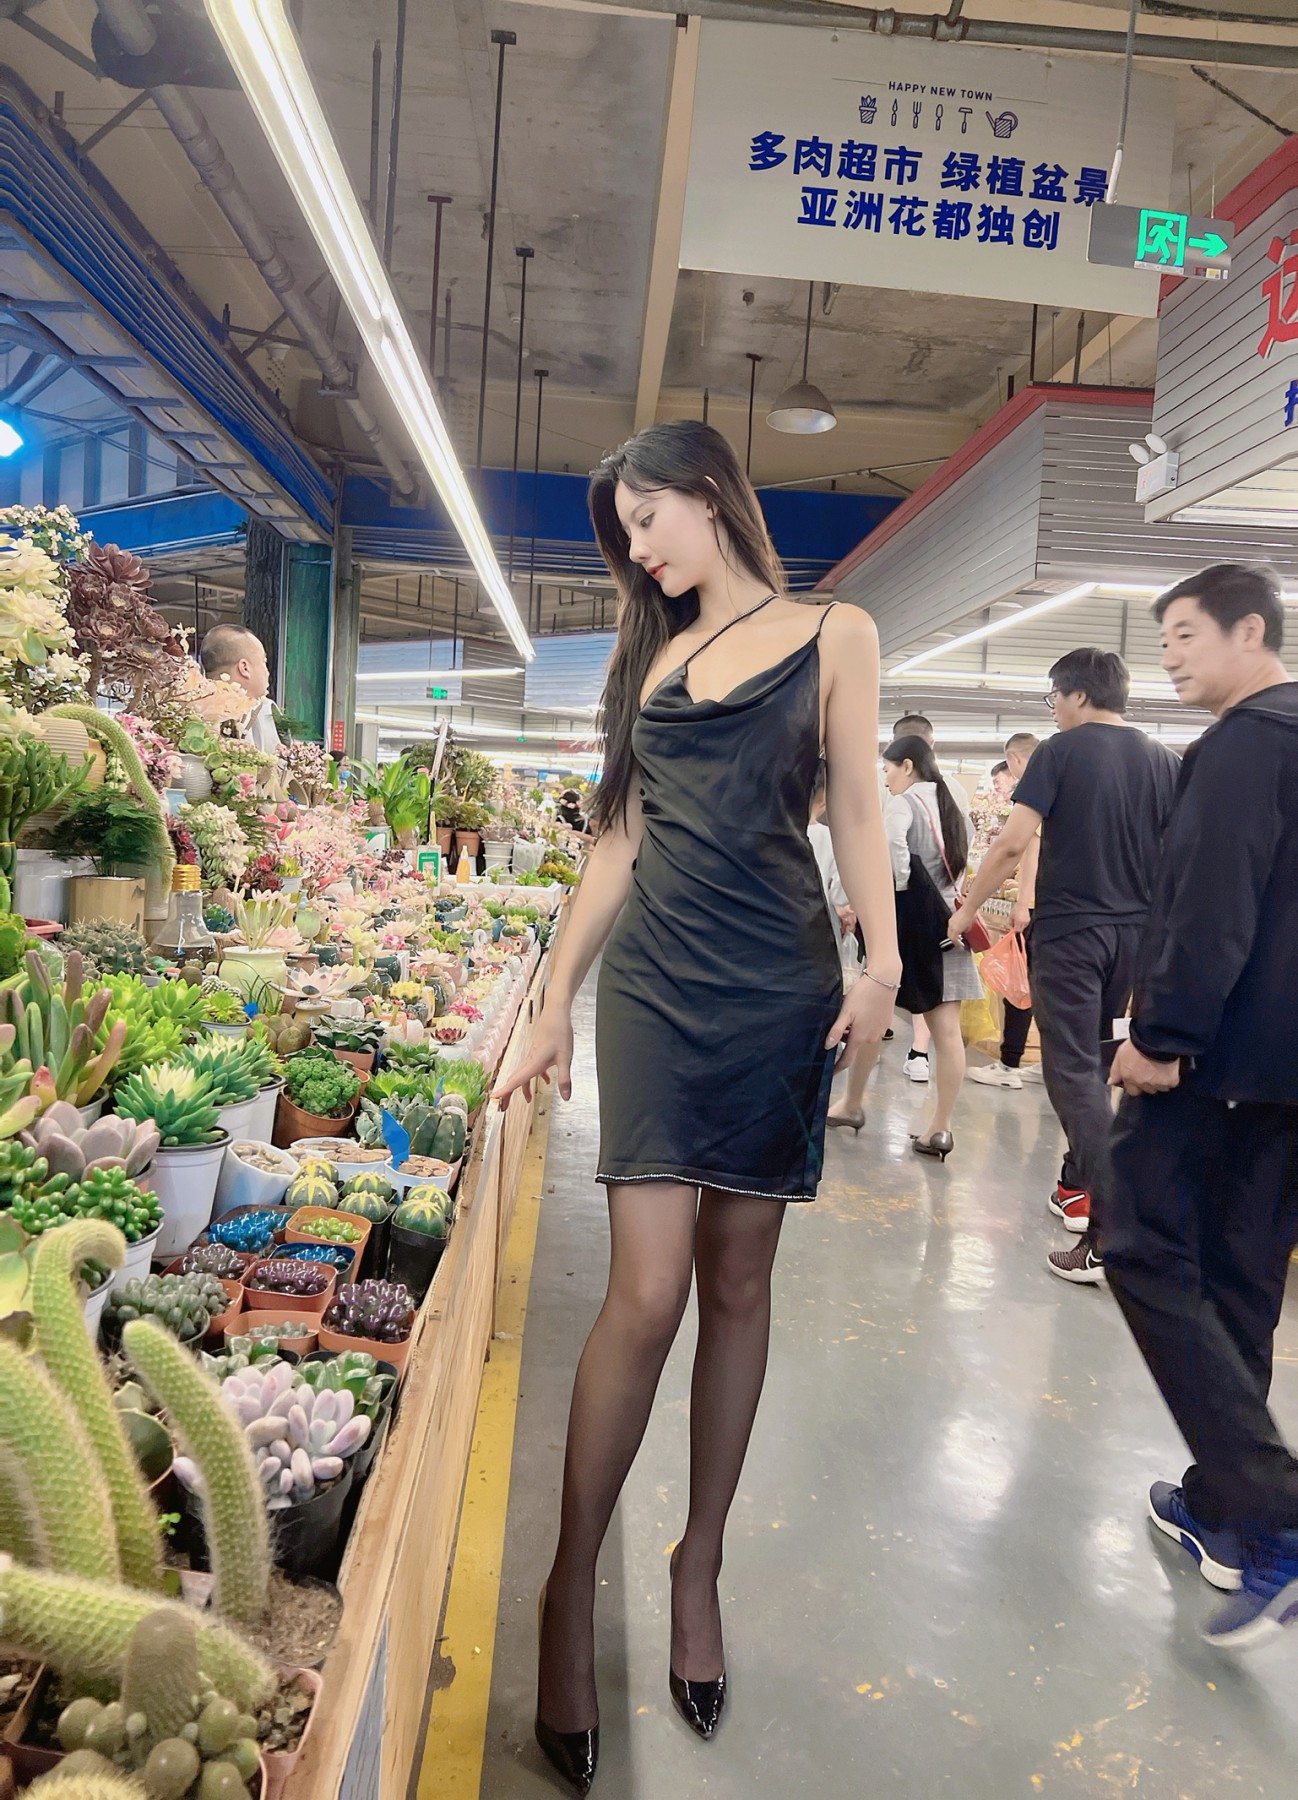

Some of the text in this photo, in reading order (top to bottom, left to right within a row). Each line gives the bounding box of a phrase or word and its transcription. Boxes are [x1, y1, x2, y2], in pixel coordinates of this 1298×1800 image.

[888, 81, 993, 101] HAPPY NEW TOWN
[748, 131, 1109, 207] 多肉超市 绿植盆景
[797, 186, 1061, 250] 亚洲花都独创
